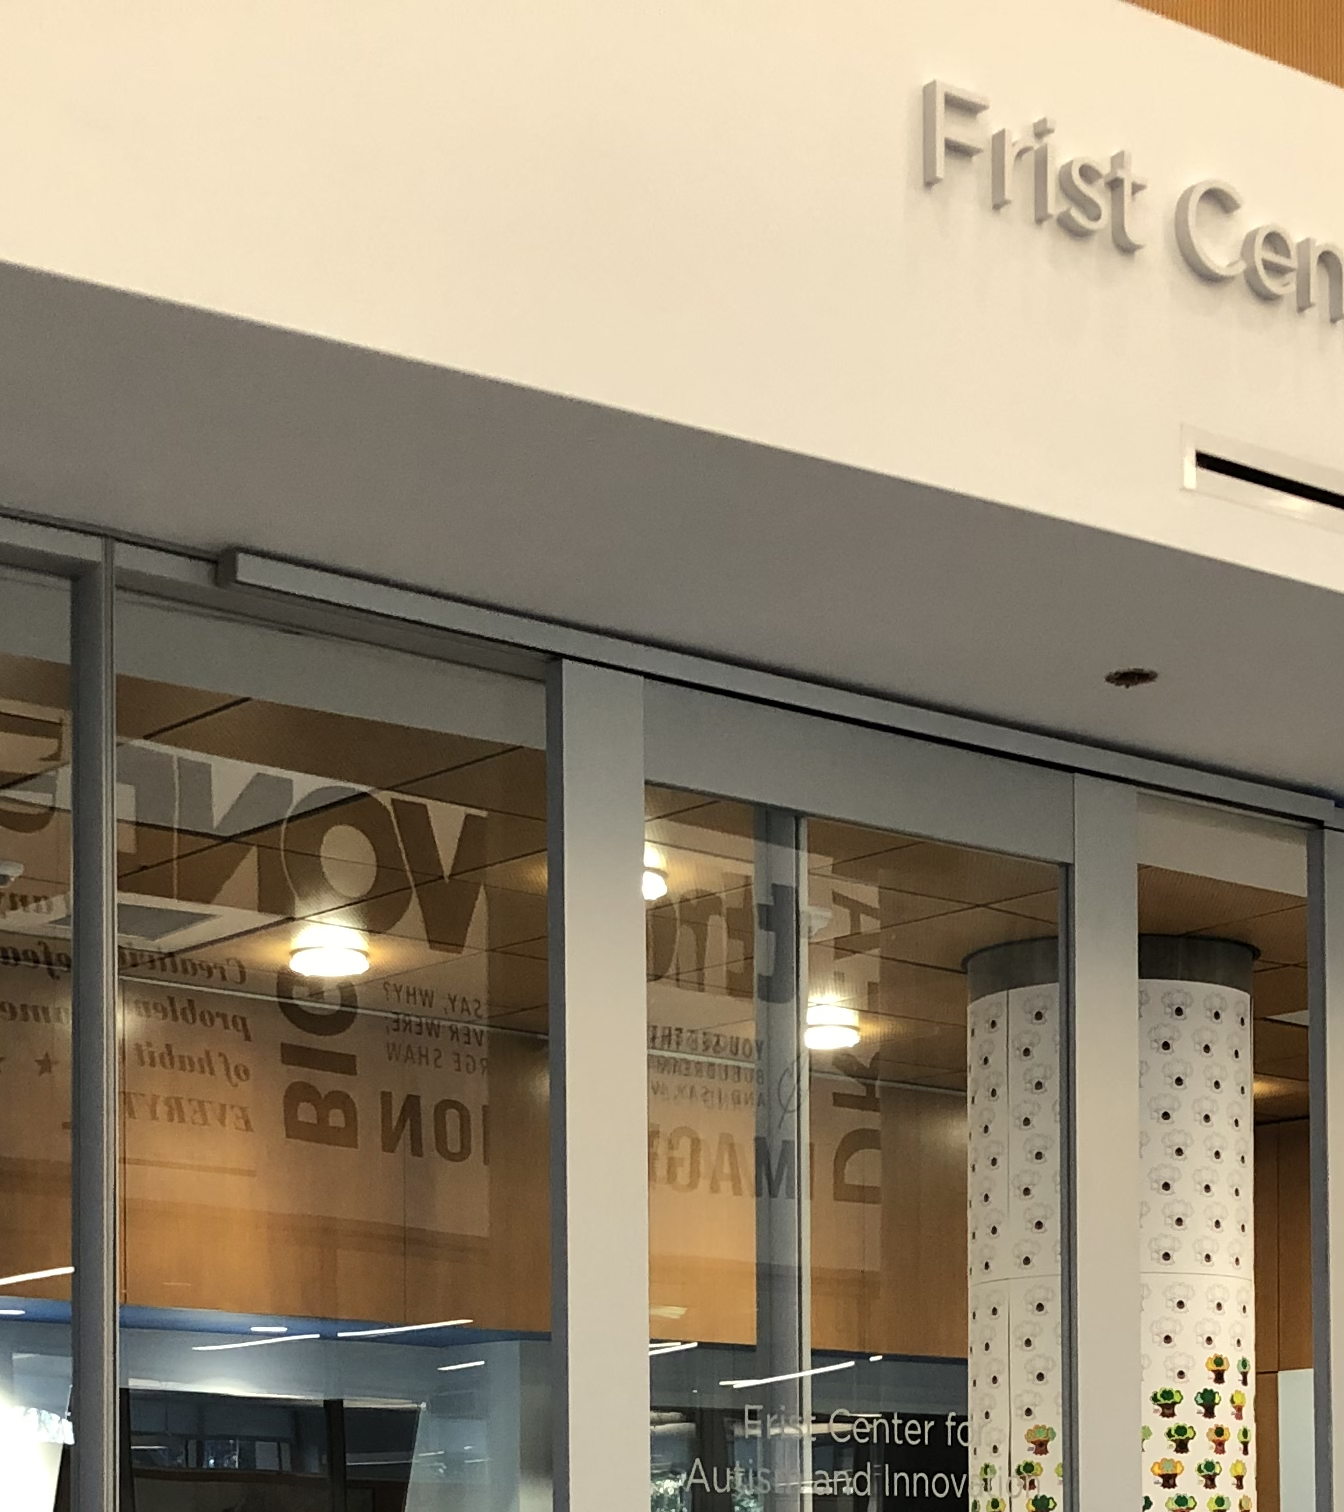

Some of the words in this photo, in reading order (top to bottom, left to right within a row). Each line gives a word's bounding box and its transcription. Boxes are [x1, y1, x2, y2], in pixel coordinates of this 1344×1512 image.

[922, 79, 1147, 254] Frist
[829, 1408, 933, 1446] Center
[685, 1458, 808, 1495] Autis
[811, 1462, 872, 1498] and
[884, 1464, 1042, 1500] Innovation
